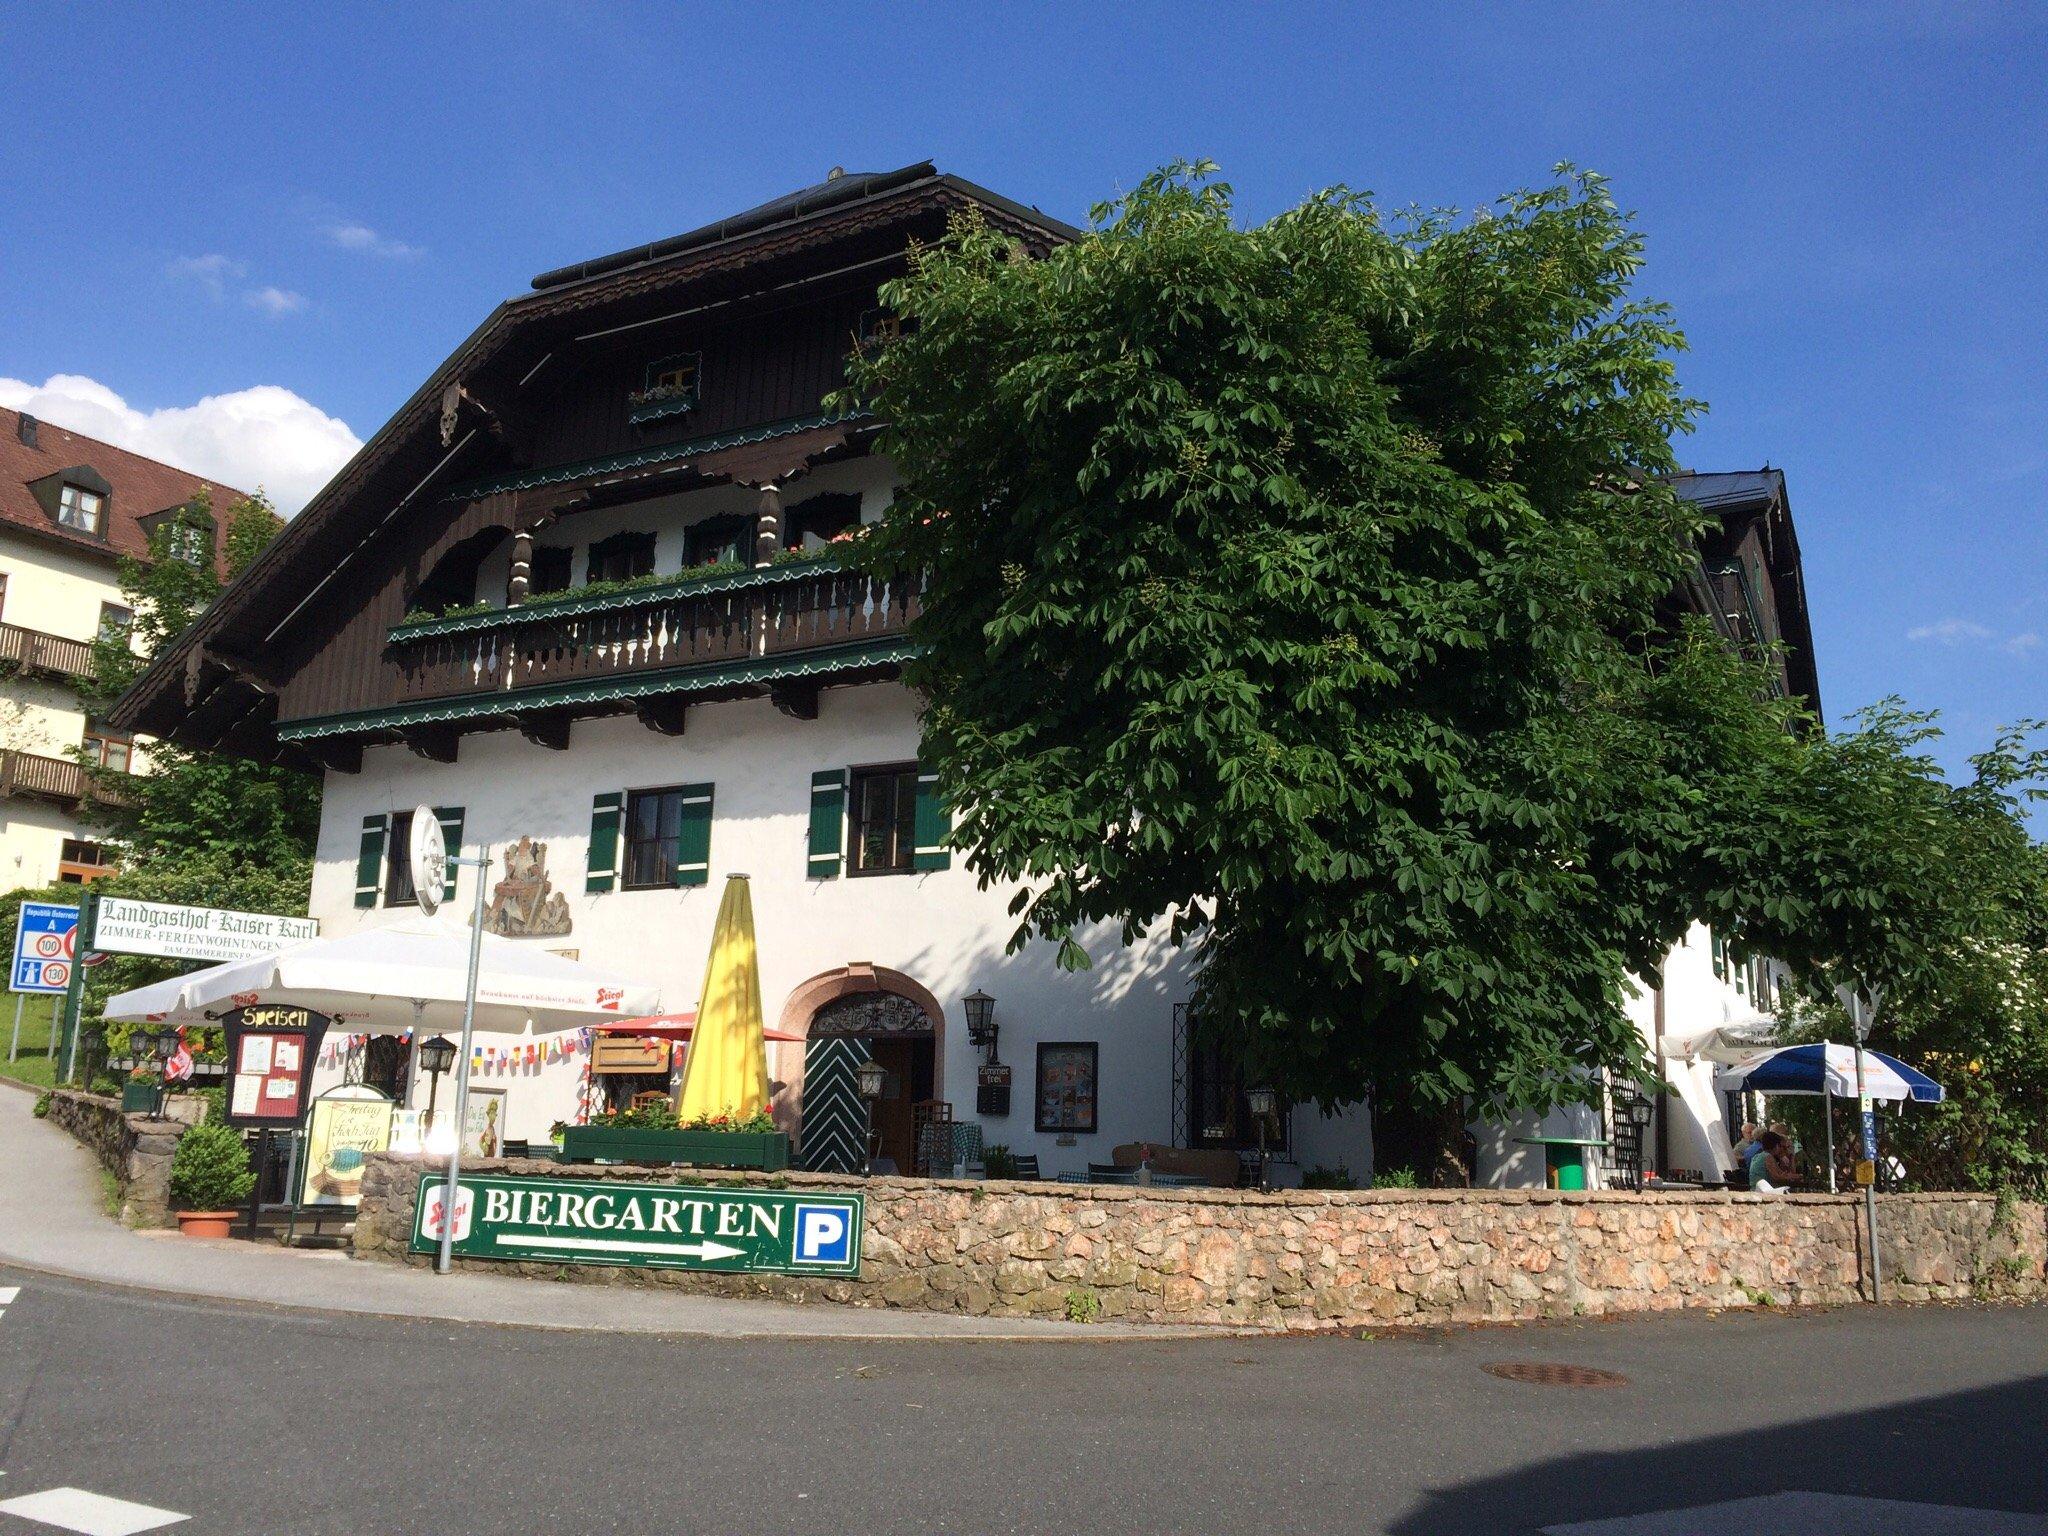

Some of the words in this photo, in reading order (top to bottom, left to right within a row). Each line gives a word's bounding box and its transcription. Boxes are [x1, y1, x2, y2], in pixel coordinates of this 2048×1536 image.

[47, 919, 56, 931] A
[278, 918, 314, 940] Karl
[41, 940, 57, 952] 100
[48, 968, 63, 980] 130
[240, 1006, 308, 1028] Speisen
[979, 1066, 1010, 1075] Zimmer
[987, 1074, 1002, 1085] frei
[481, 1188, 785, 1239] BIERGARTEN
[803, 1212, 843, 1257] P
